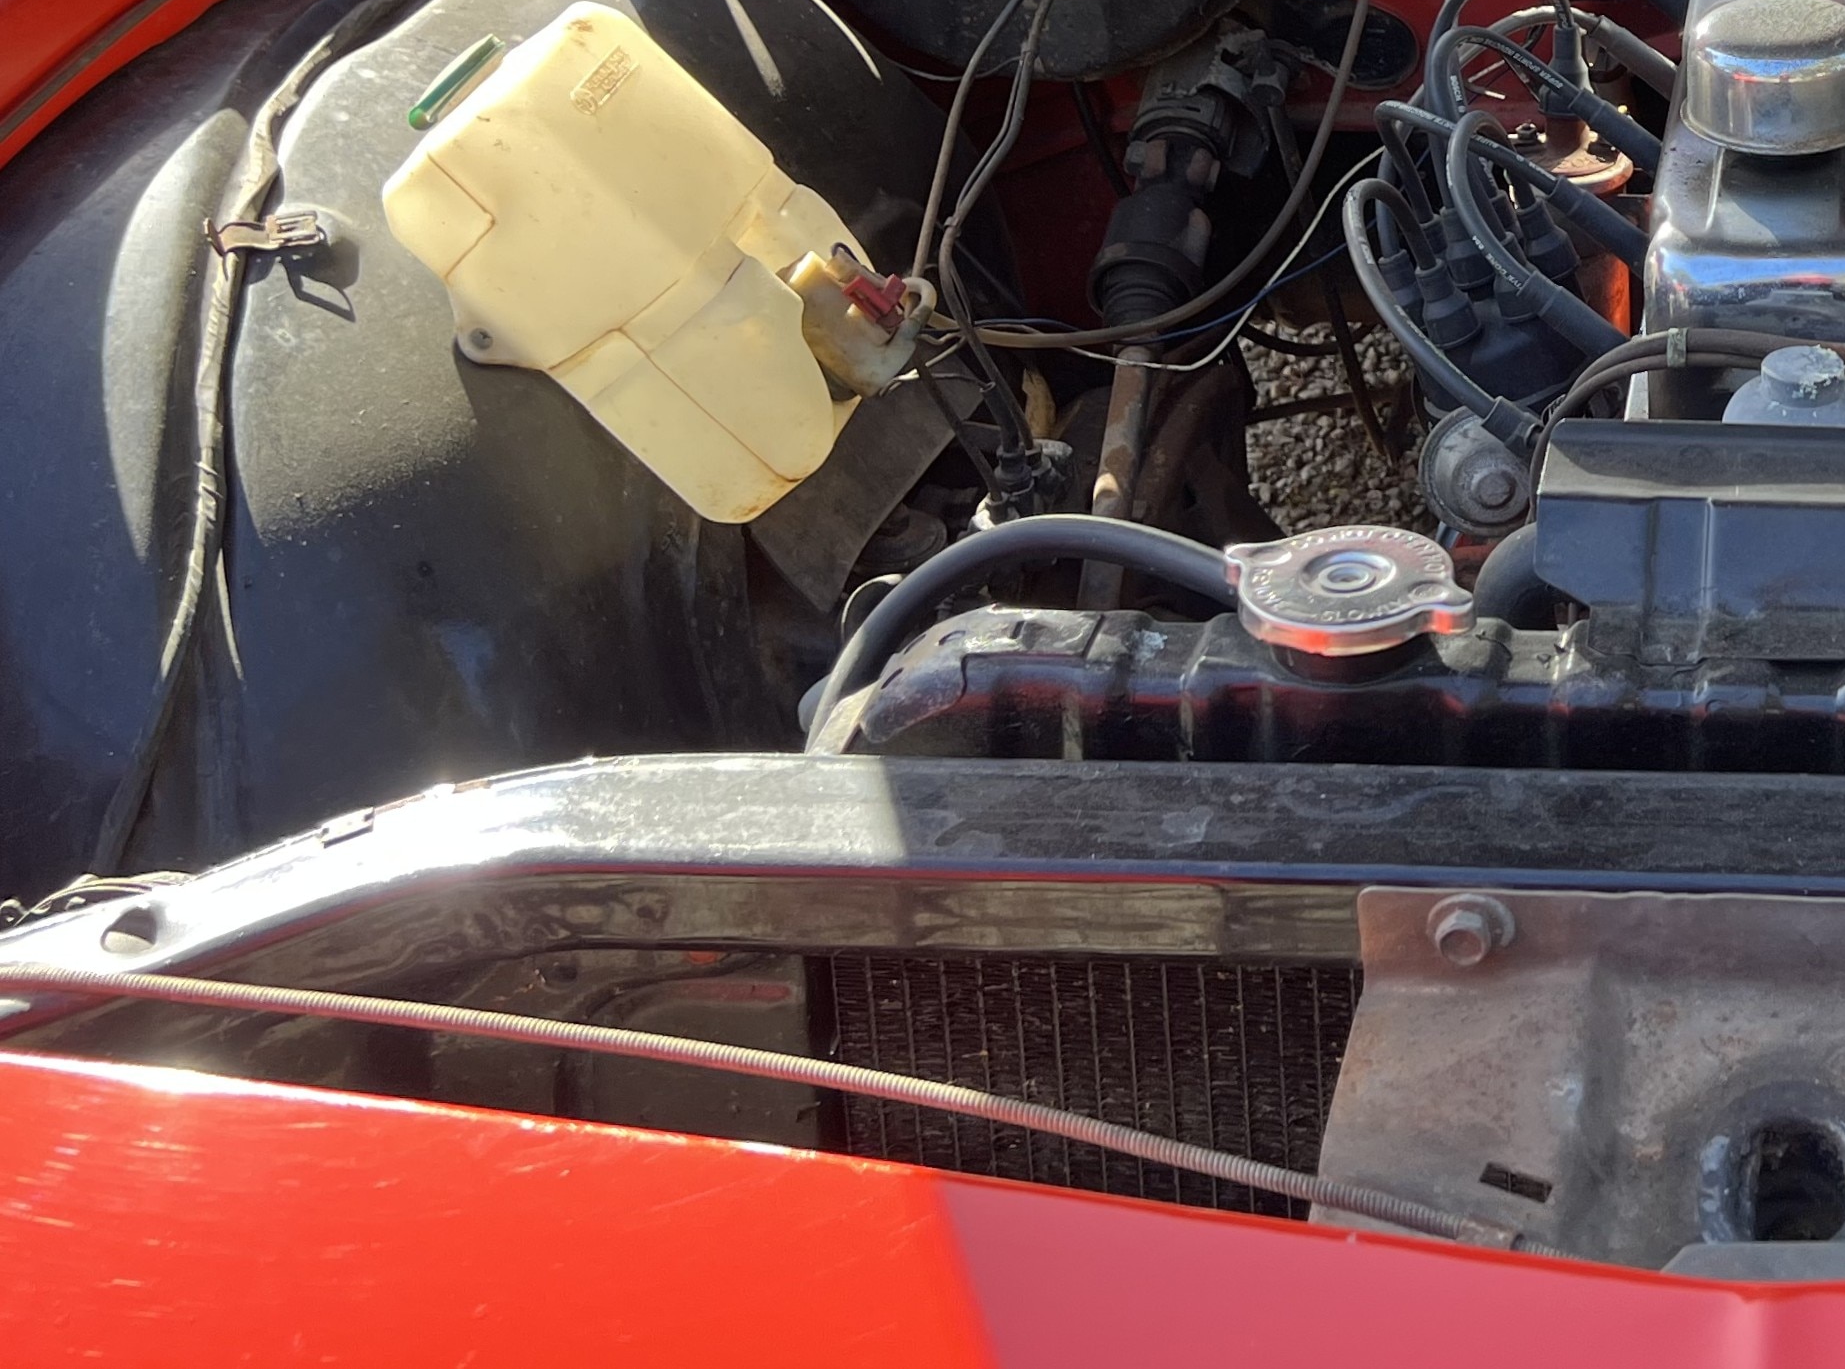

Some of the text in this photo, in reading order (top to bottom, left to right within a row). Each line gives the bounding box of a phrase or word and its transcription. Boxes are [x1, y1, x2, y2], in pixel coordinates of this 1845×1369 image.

[1512, 50, 1541, 74] SPORTS
[1449, 74, 1463, 102] BOSCH
[1538, 68, 1564, 90] SUPER
